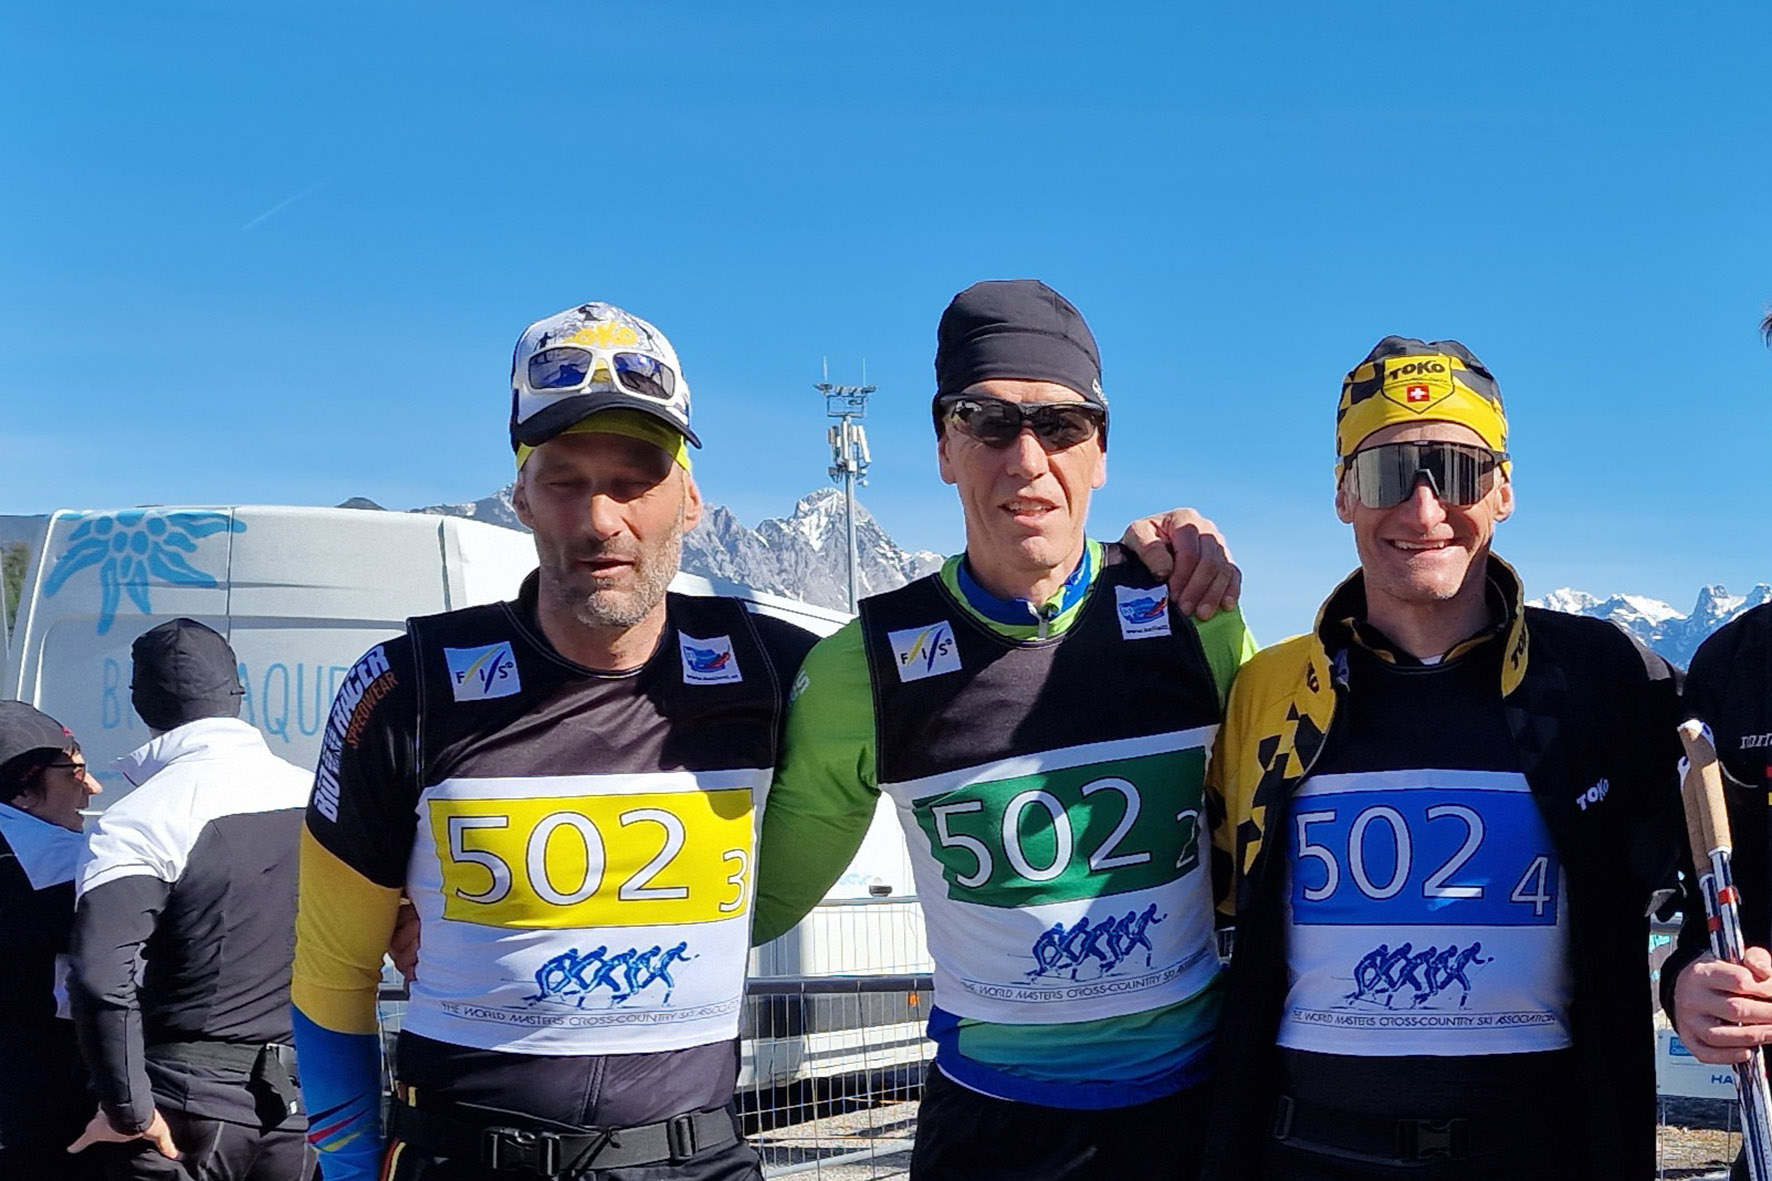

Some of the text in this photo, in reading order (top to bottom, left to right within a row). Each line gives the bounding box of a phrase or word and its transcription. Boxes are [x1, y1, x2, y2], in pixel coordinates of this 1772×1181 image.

[1389, 360, 1446, 381] TOKO
[930, 777, 1200, 889] 502 2
[447, 808, 749, 914] 502 3
[1296, 804, 1551, 916] 502 4
[1015, 989, 1064, 1001] MASTERS
[1066, 974, 1160, 998] CROSS-COUNTRY
[464, 1007, 505, 1021] WORLD
[509, 1014, 564, 1027] MASTERS
[569, 1012, 676, 1026] CROSS-COUNTRY
[1304, 1012, 1333, 1024] WORLD
[1335, 1015, 1376, 1027] MASTERS
[1379, 1015, 1474, 1028] CROSS-COUNTRY
[1476, 1016, 1493, 1026] SKI
[1711, 1075, 1734, 1085] HA
